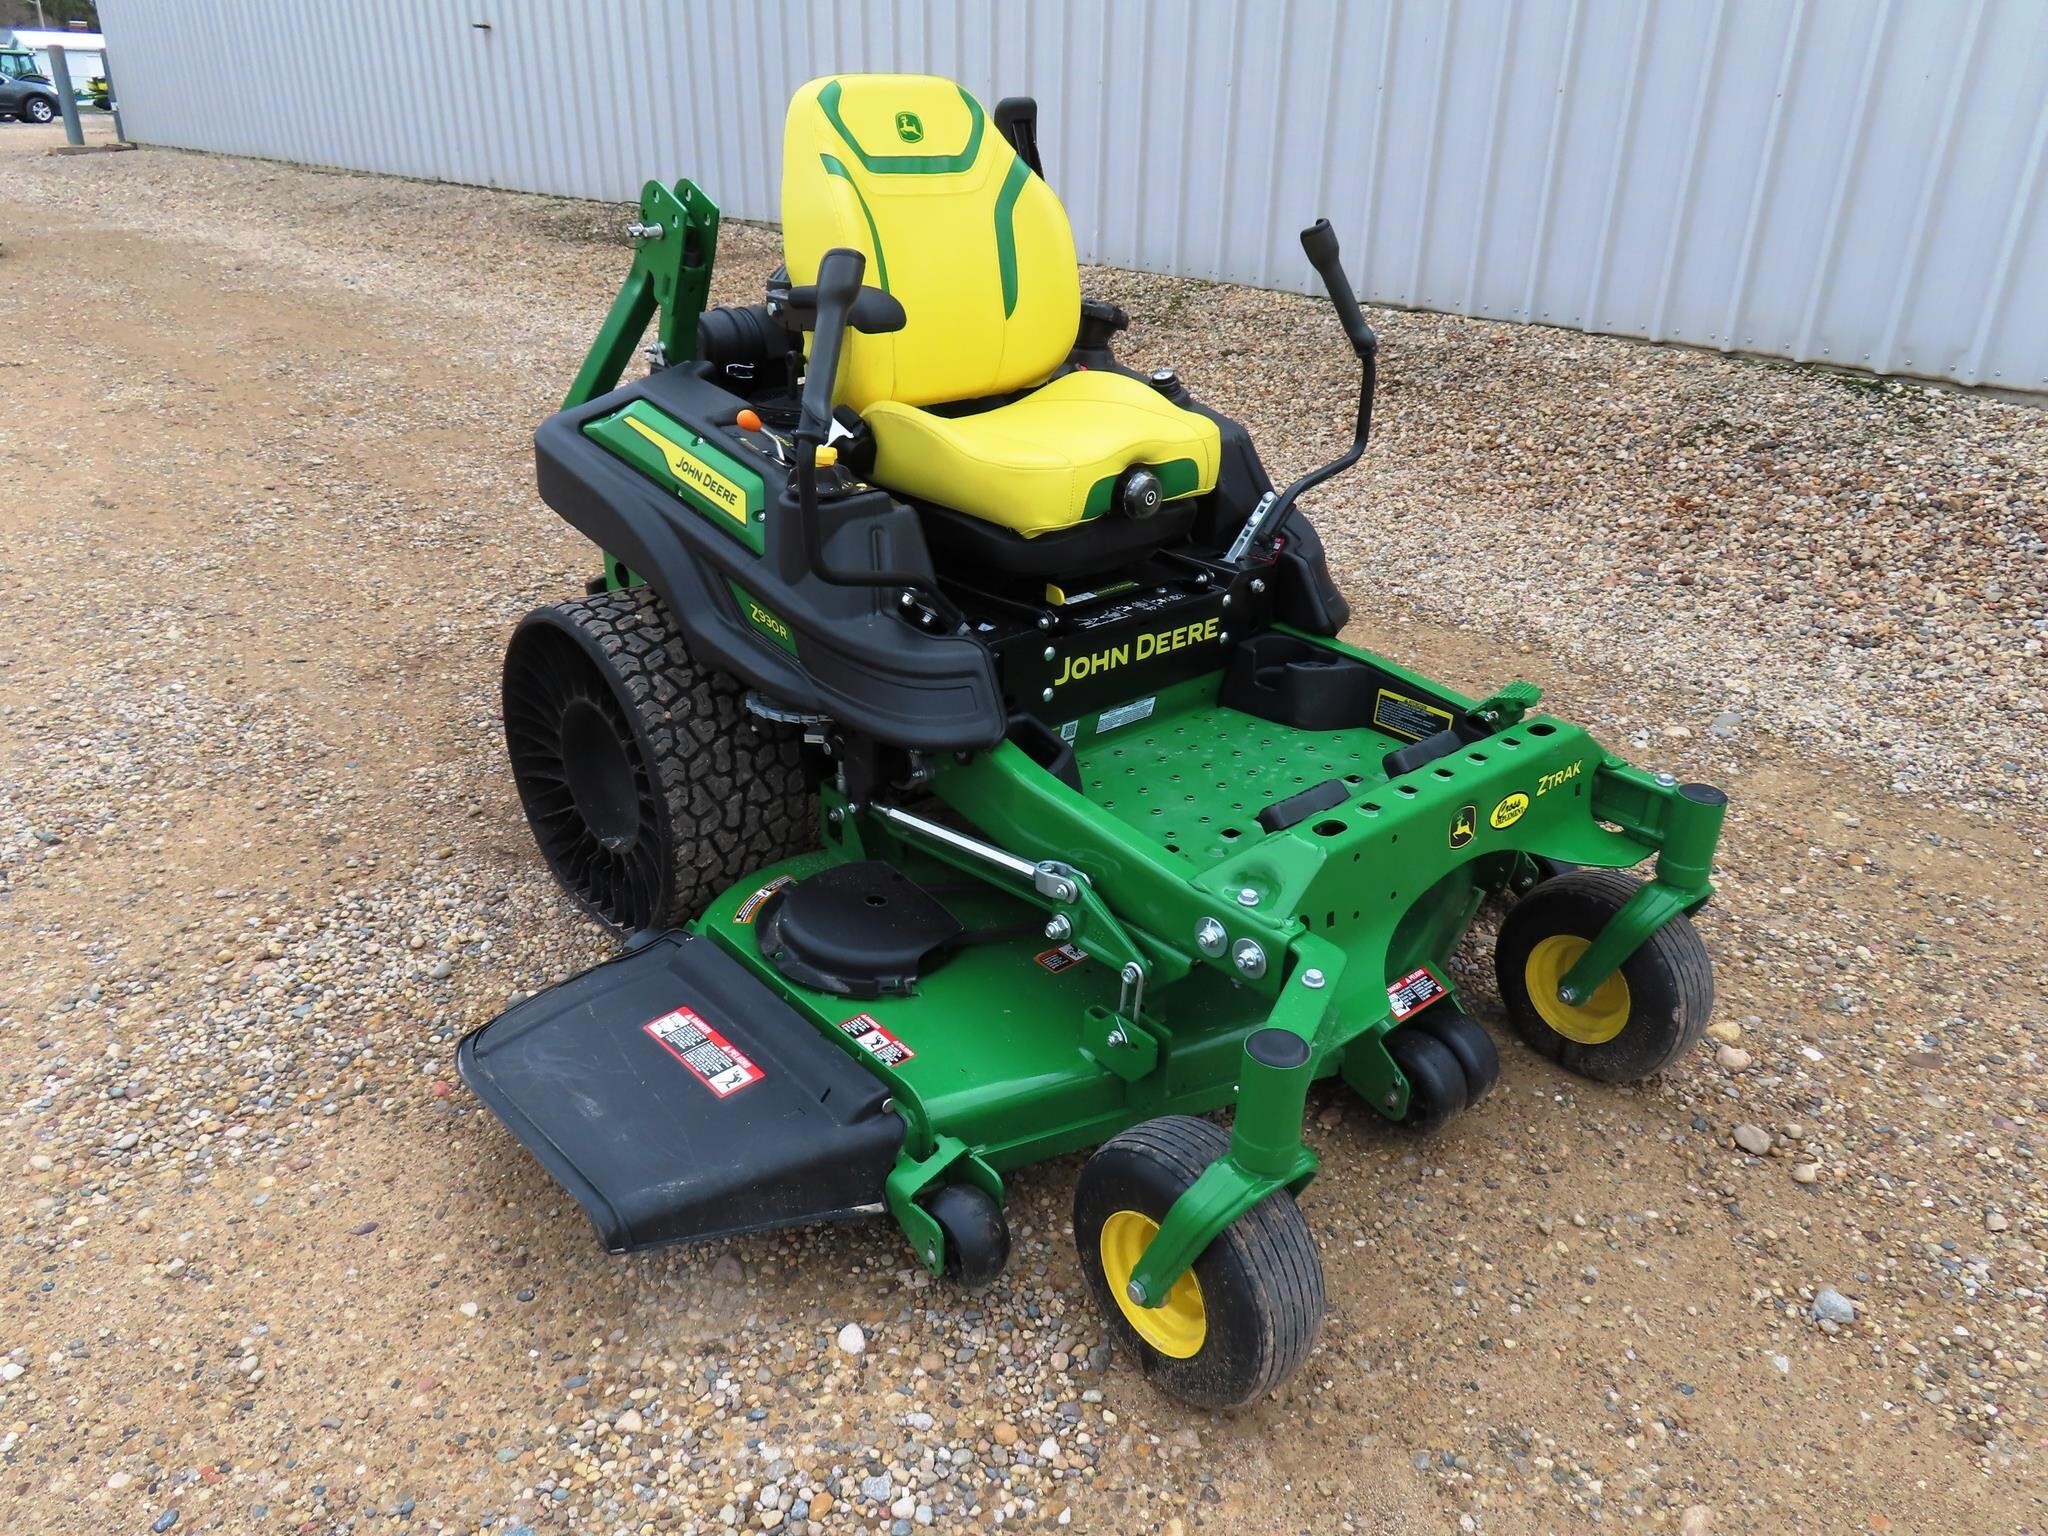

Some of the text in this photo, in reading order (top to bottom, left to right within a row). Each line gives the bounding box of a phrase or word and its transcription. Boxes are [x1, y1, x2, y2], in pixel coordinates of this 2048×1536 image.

[676, 457, 737, 505] JOHN DEERE
[750, 603, 788, 640] Z930R
[1055, 617, 1219, 686] JOHN DEERE
[1536, 760, 1582, 796] ZTRAK
